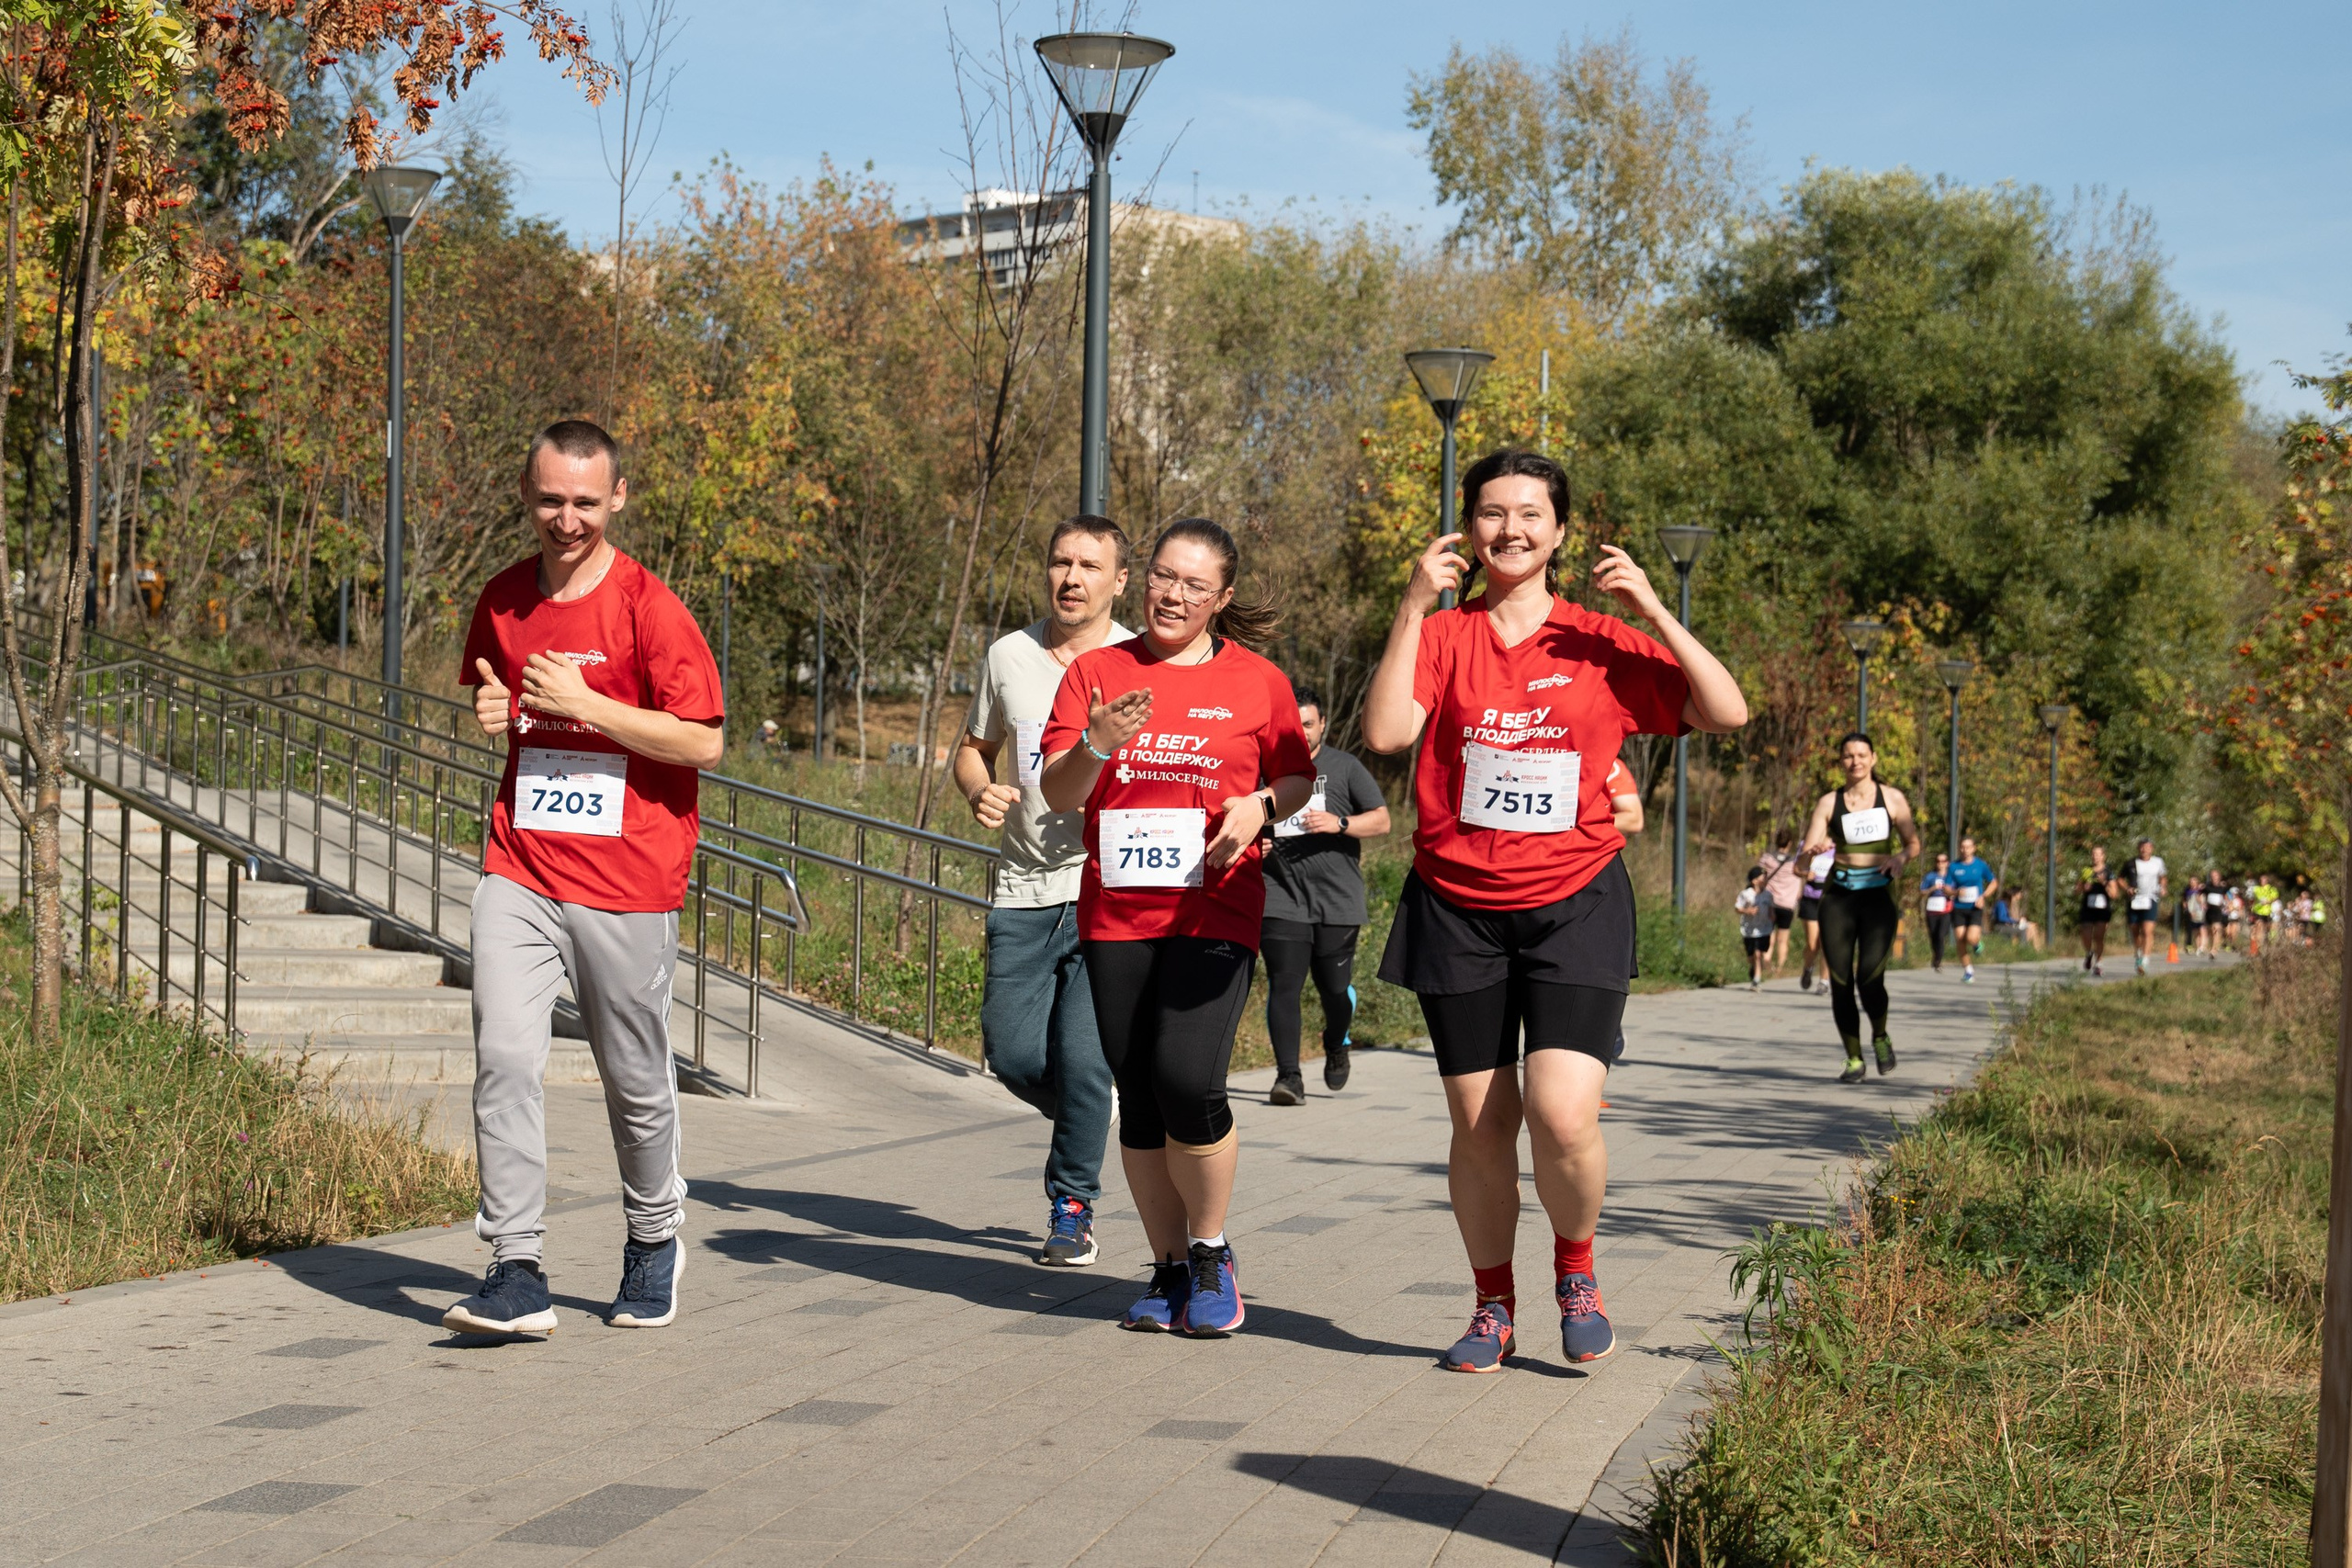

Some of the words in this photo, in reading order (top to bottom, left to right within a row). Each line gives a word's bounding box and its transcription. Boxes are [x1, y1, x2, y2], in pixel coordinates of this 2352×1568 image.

[533, 718, 600, 734] МИЛОСЕРД
[1480, 708, 1498, 726] Я
[1500, 706, 1552, 729] БЕГУ
[1136, 732, 1153, 748] Я
[1155, 733, 1210, 751] БЕГУ
[1464, 726, 1473, 738] В
[1474, 726, 1569, 745] ПОДДЕРЖКУ
[1030, 752, 1042, 771] 7
[1118, 749, 1128, 761] В
[1130, 749, 1224, 770] ПОДДЕРЖКУ
[1136, 770, 1220, 790] МИЛОСЕРДИЕ
[531, 788, 604, 817] 7203
[1484, 787, 1554, 816] 7513
[1119, 847, 1182, 869] 7183
